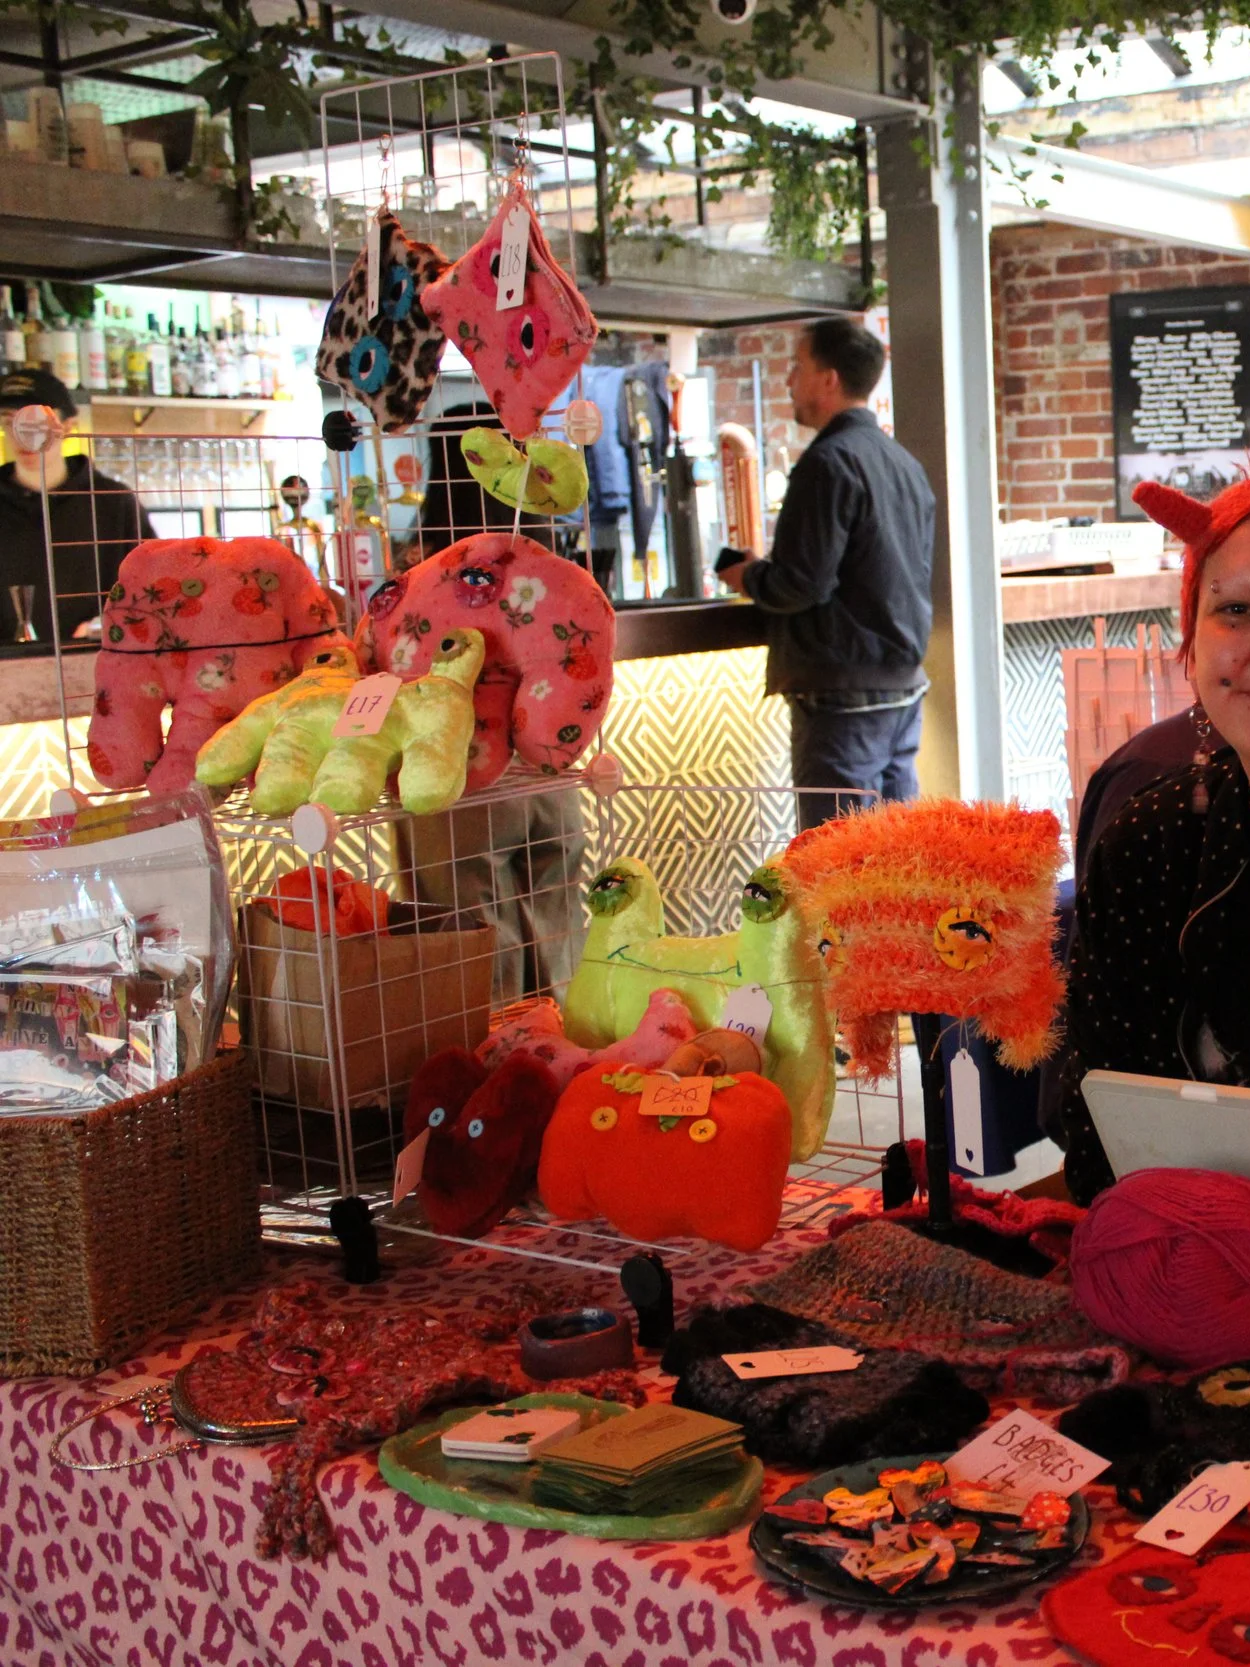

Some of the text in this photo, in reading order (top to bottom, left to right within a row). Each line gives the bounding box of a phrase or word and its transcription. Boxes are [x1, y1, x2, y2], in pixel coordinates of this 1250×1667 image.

[346, 695, 383, 715] £17
[992, 1423, 1085, 1484] BADGES
[1175, 1483, 1231, 1513] £30
